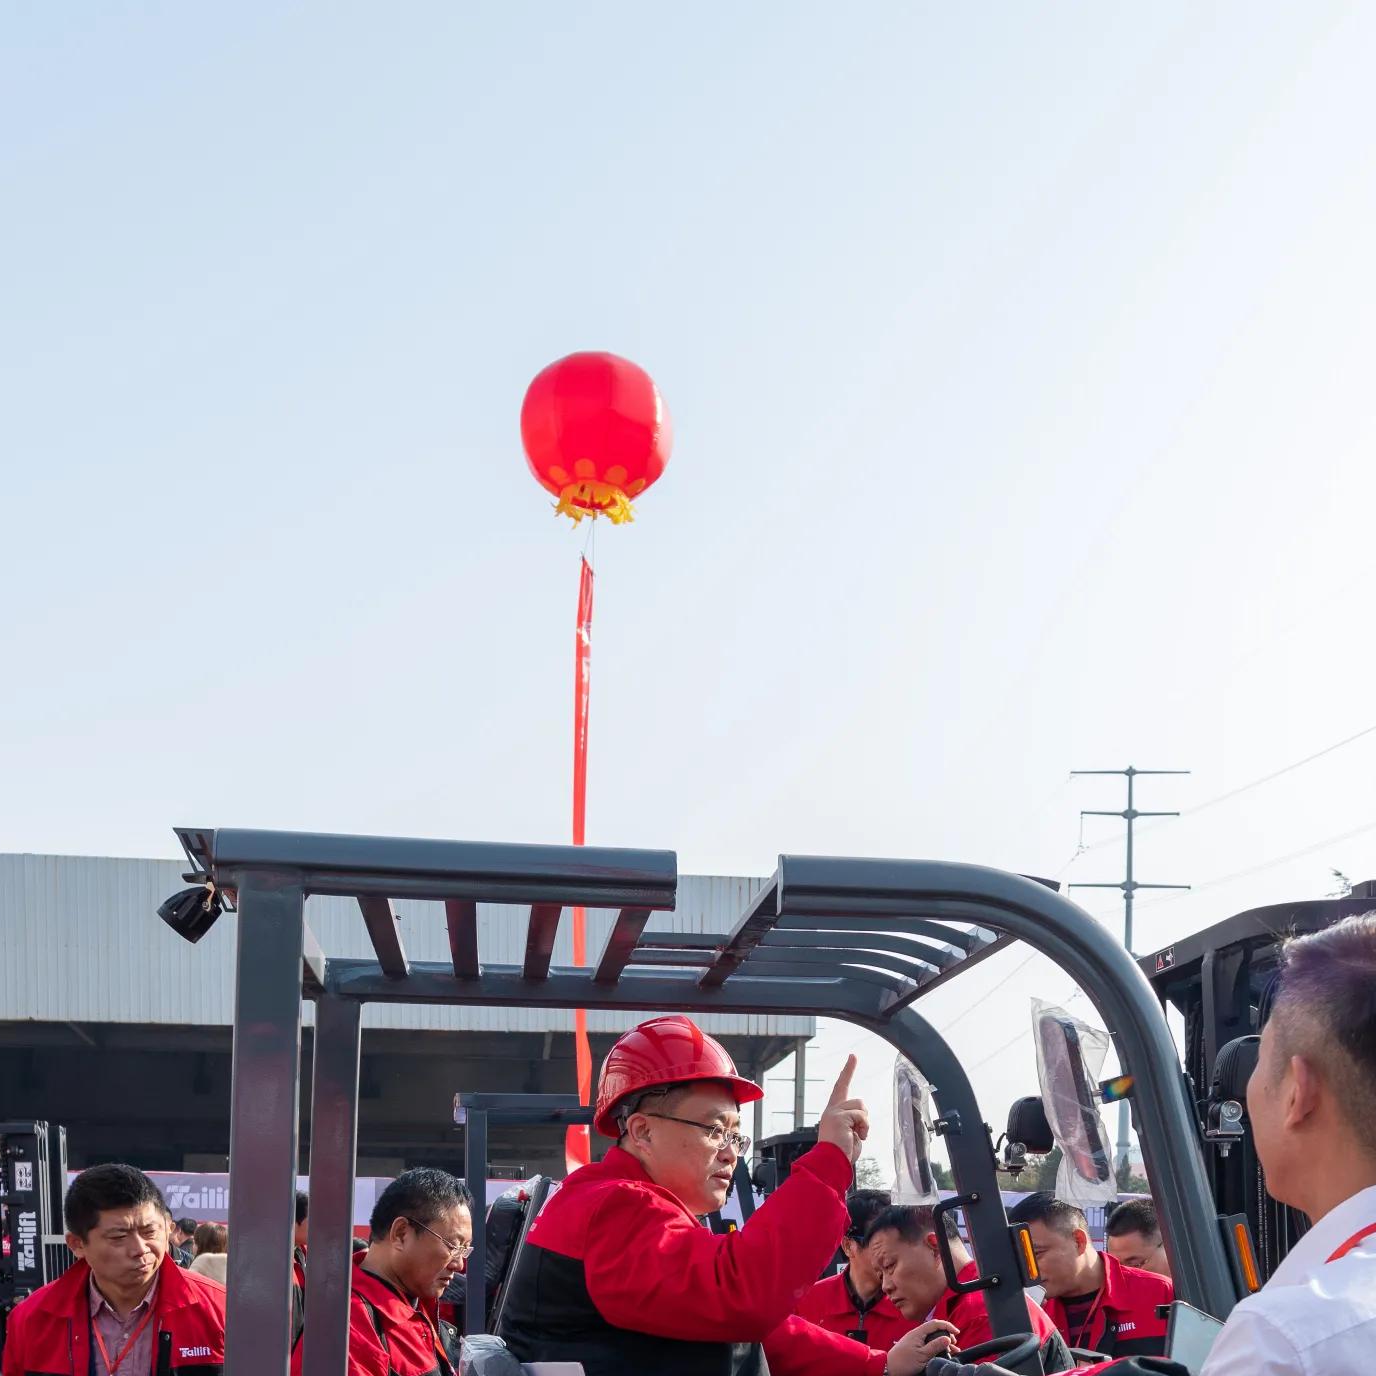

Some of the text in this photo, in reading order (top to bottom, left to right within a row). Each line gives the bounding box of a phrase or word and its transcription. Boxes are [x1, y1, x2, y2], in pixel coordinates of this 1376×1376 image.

[166, 1184, 229, 1209] Taili
[17, 1211, 38, 1272] Tailift
[179, 1346, 211, 1358] Tailift
